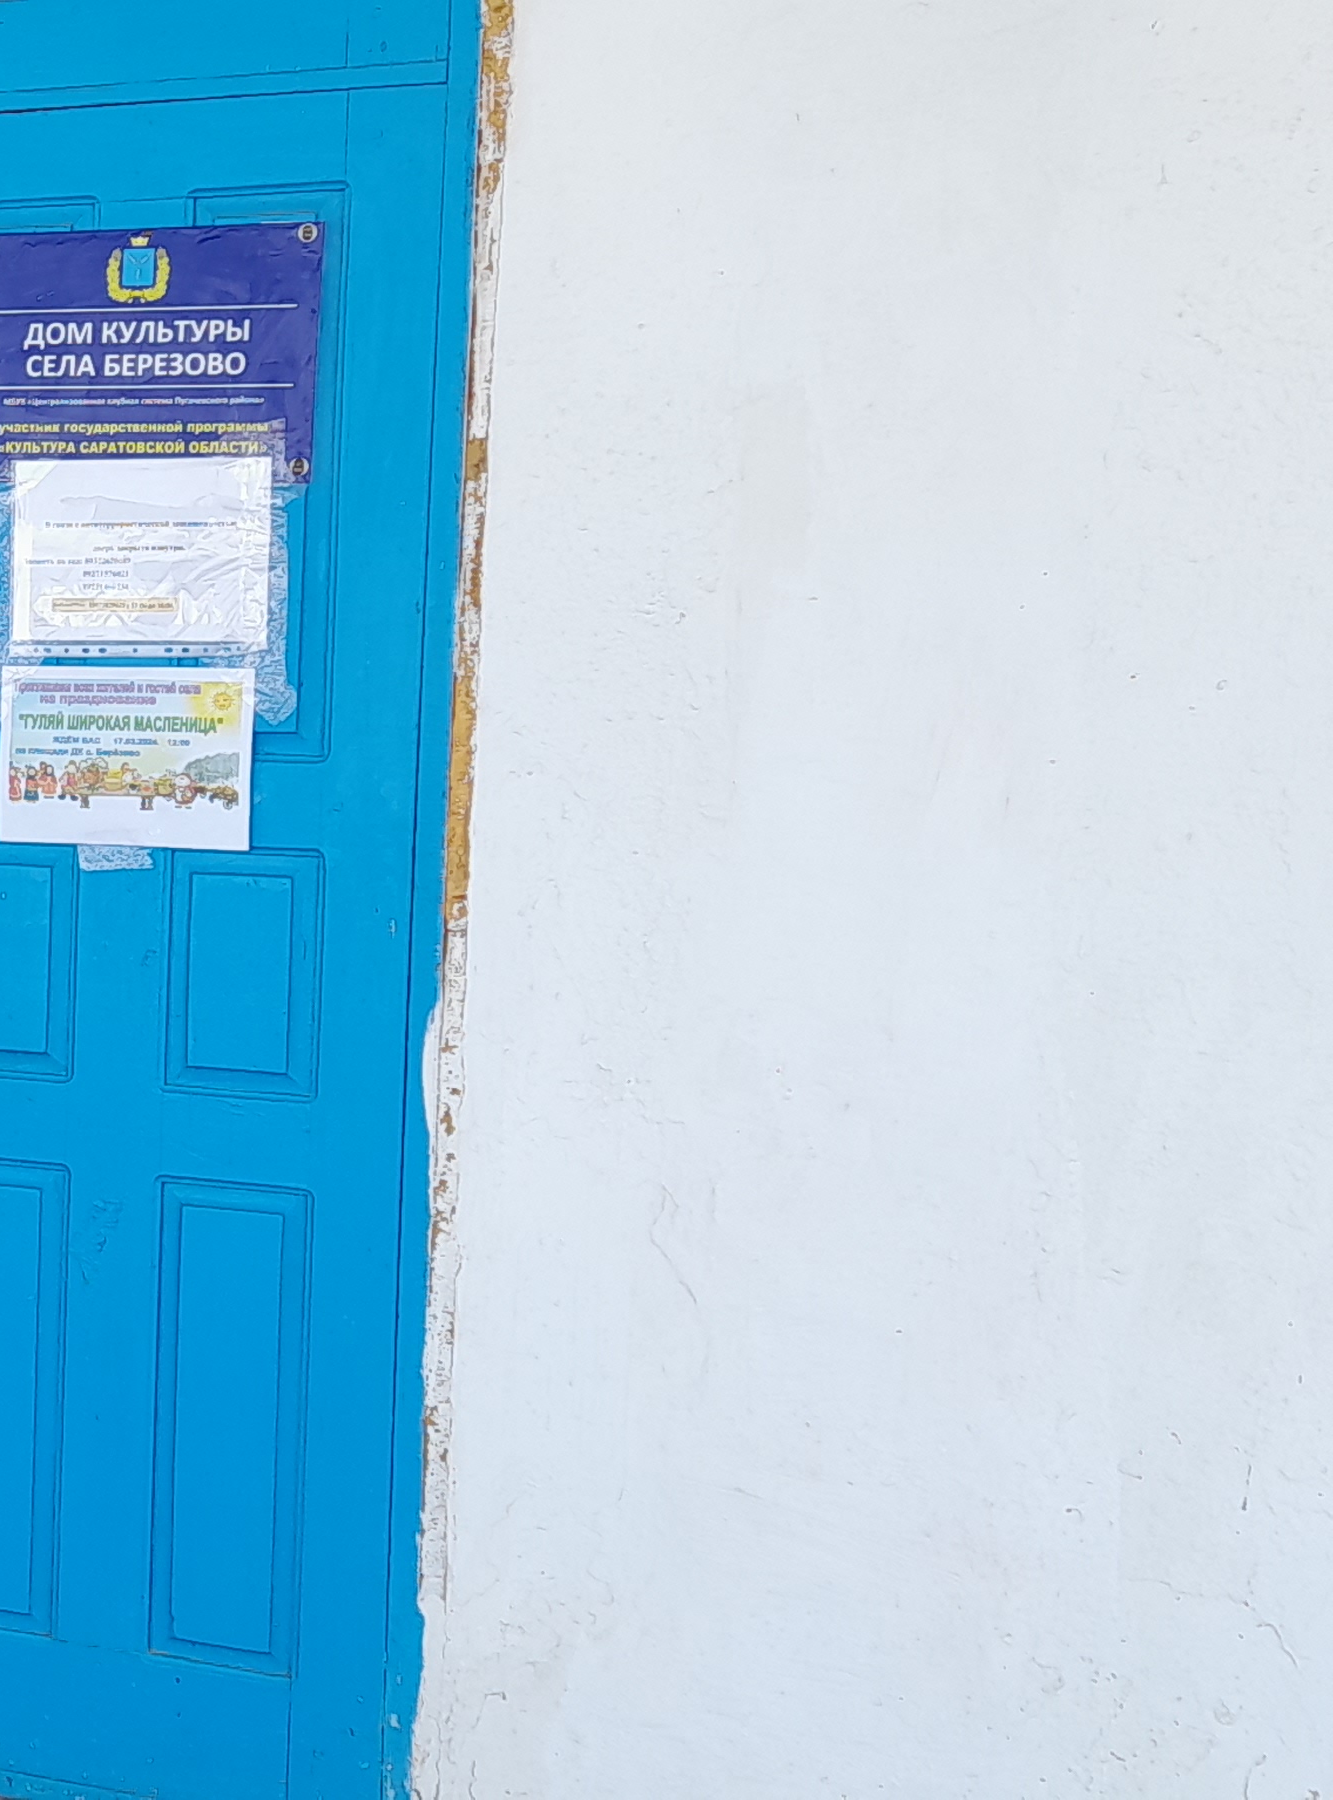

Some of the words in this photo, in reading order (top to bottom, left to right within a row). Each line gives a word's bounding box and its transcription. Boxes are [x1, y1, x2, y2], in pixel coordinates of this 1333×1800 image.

[23, 321, 93, 350] ДОМ
[101, 319, 251, 344] КУЛЬТУРЫ
[26, 354, 96, 378] СЕЛА
[104, 352, 247, 377] БЕРЕЗОВО
[64, 420, 183, 436] государственной
[187, 422, 269, 435] программы
[79, 438, 185, 454] САРАТОВСКОЙ
[189, 440, 268, 454] ОБЛАСТИ»
[67, 714, 131, 732] ШИРОКАЯ
[134, 716, 224, 736] МАСЛЕНИЦА"
